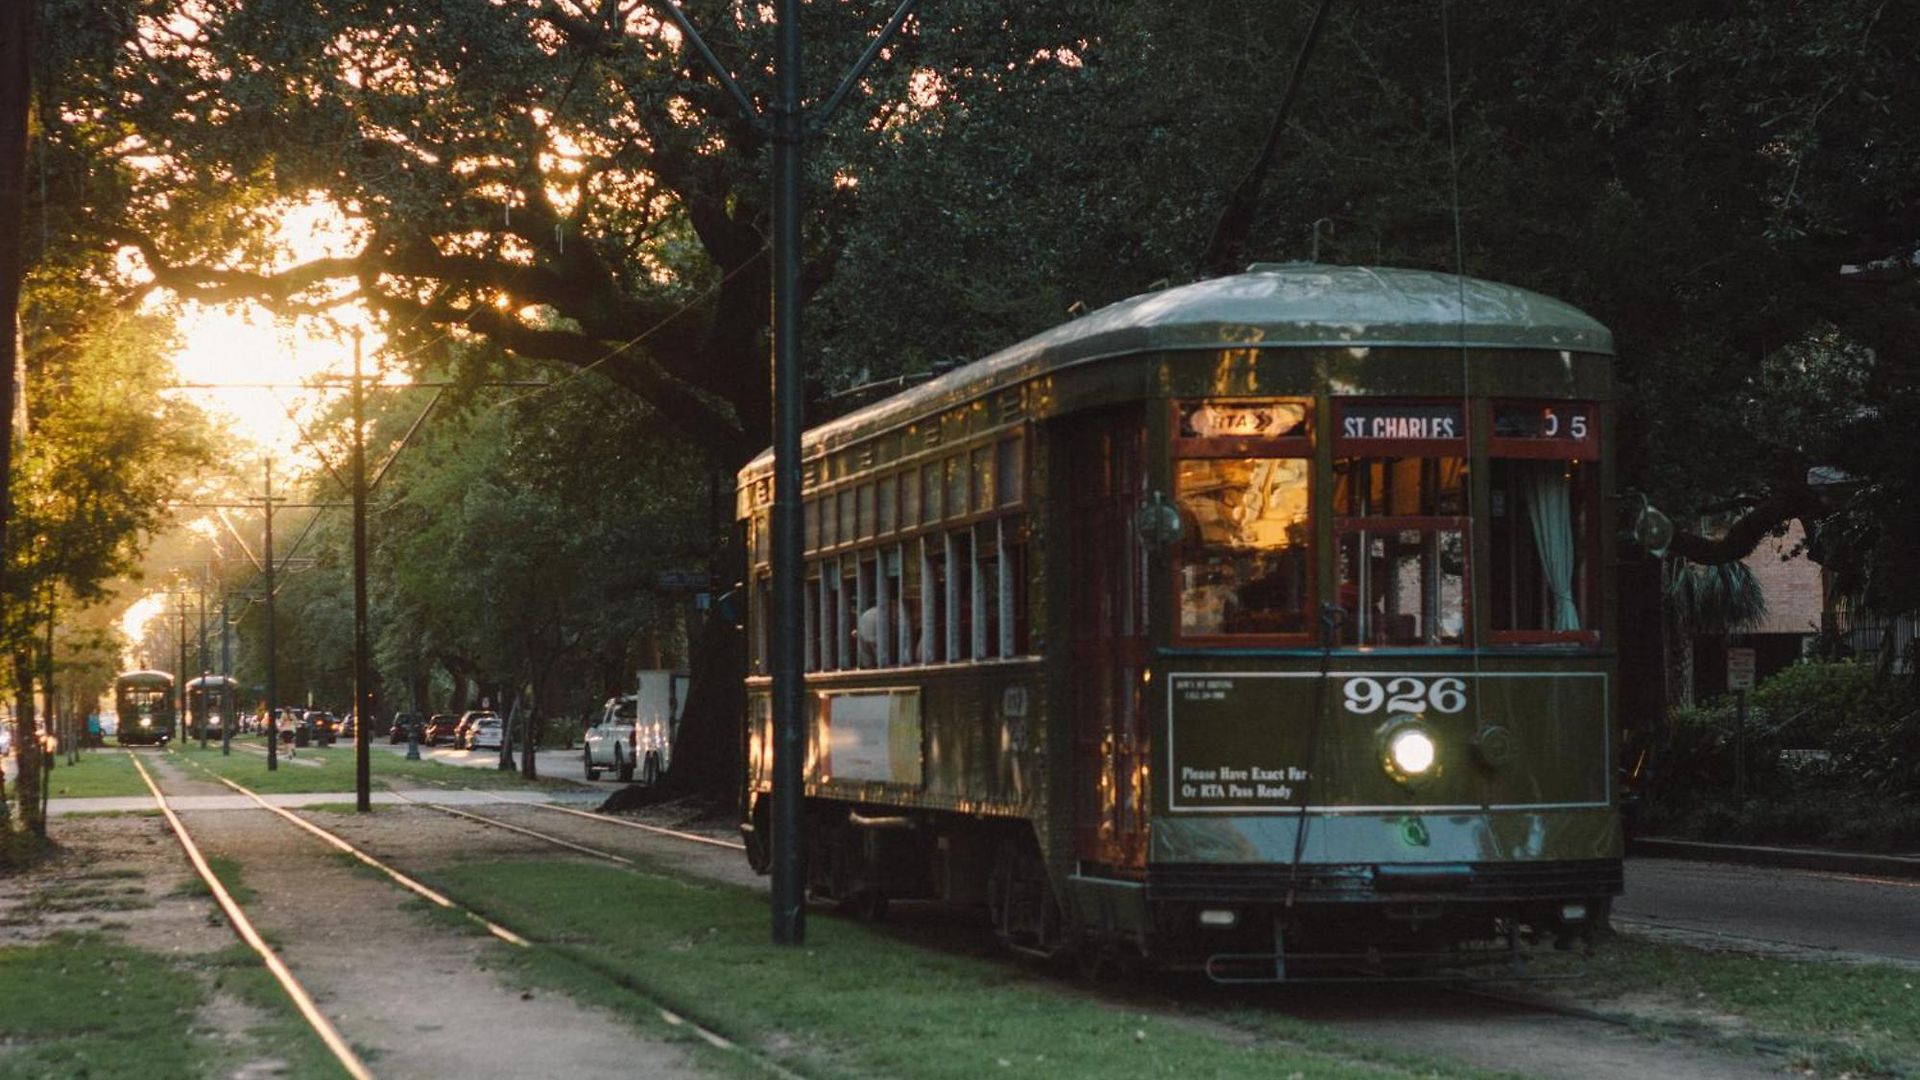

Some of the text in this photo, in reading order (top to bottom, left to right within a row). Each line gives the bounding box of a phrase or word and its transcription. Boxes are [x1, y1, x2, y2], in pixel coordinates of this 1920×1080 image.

[1372, 416, 1454, 438] CHARLES
[1343, 677, 1467, 714] 926
[1182, 766, 1312, 780] Please Have Exact Far
[1182, 784, 1292, 800] Or RTA Pass Ready
